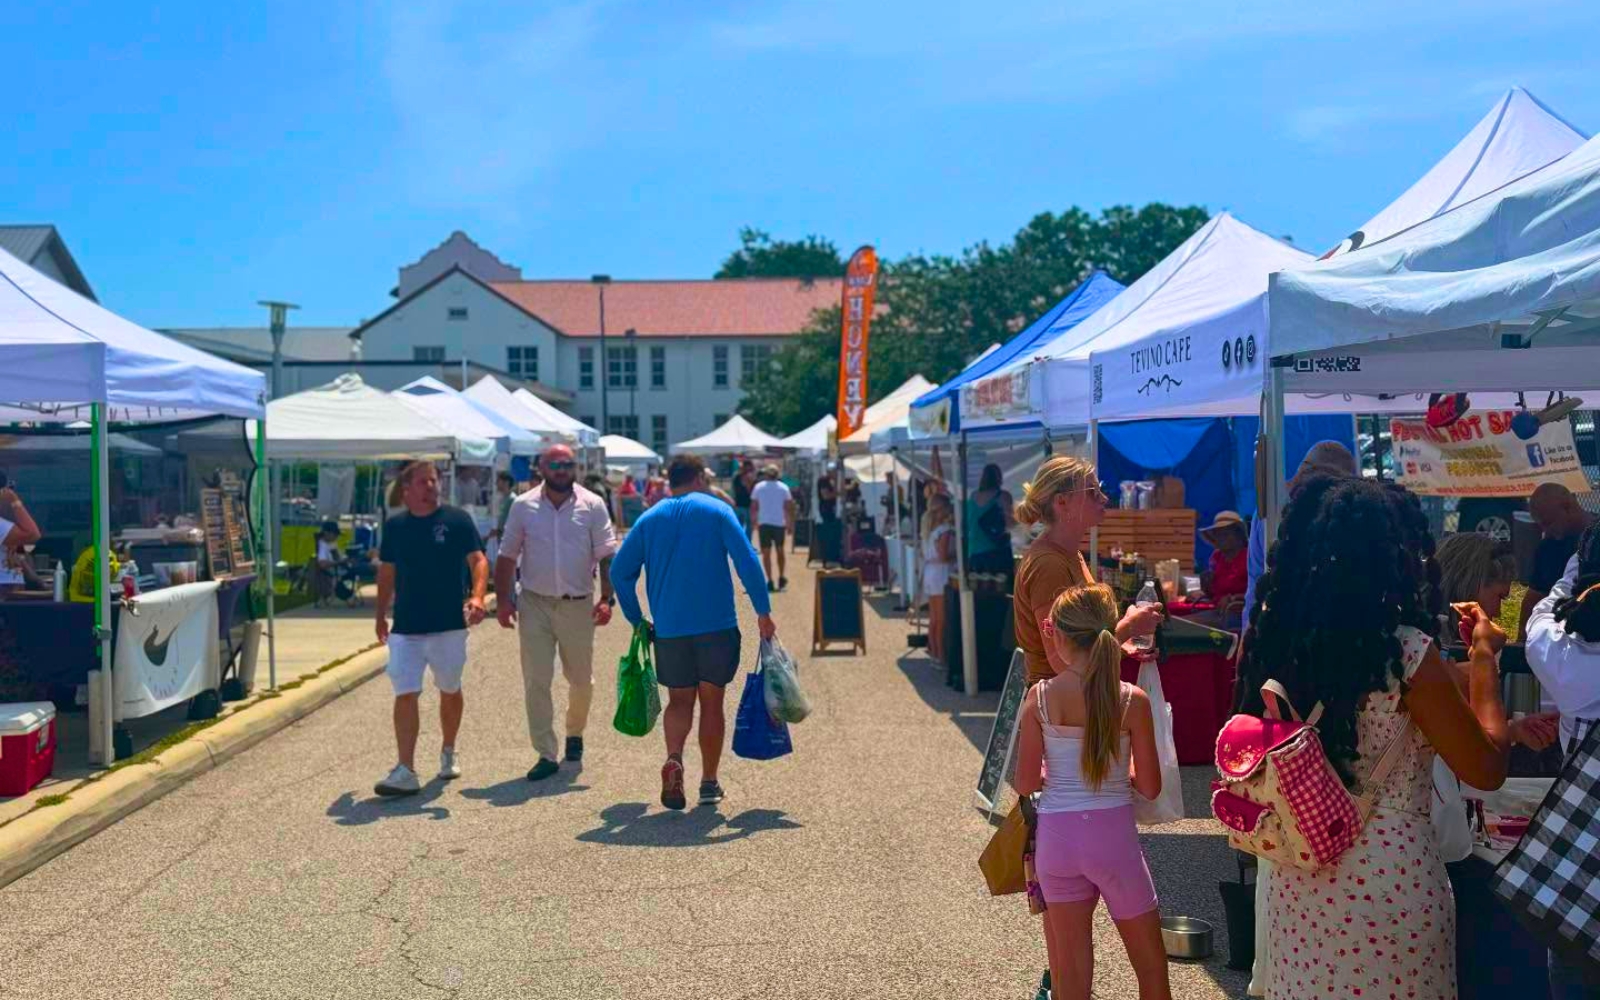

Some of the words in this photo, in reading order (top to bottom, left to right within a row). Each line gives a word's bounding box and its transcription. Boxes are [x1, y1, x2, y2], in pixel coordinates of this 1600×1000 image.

[1130, 343, 1162, 375] TEVINO
[1164, 335, 1191, 365] CAFE
[1449, 414, 1484, 442] HOT
